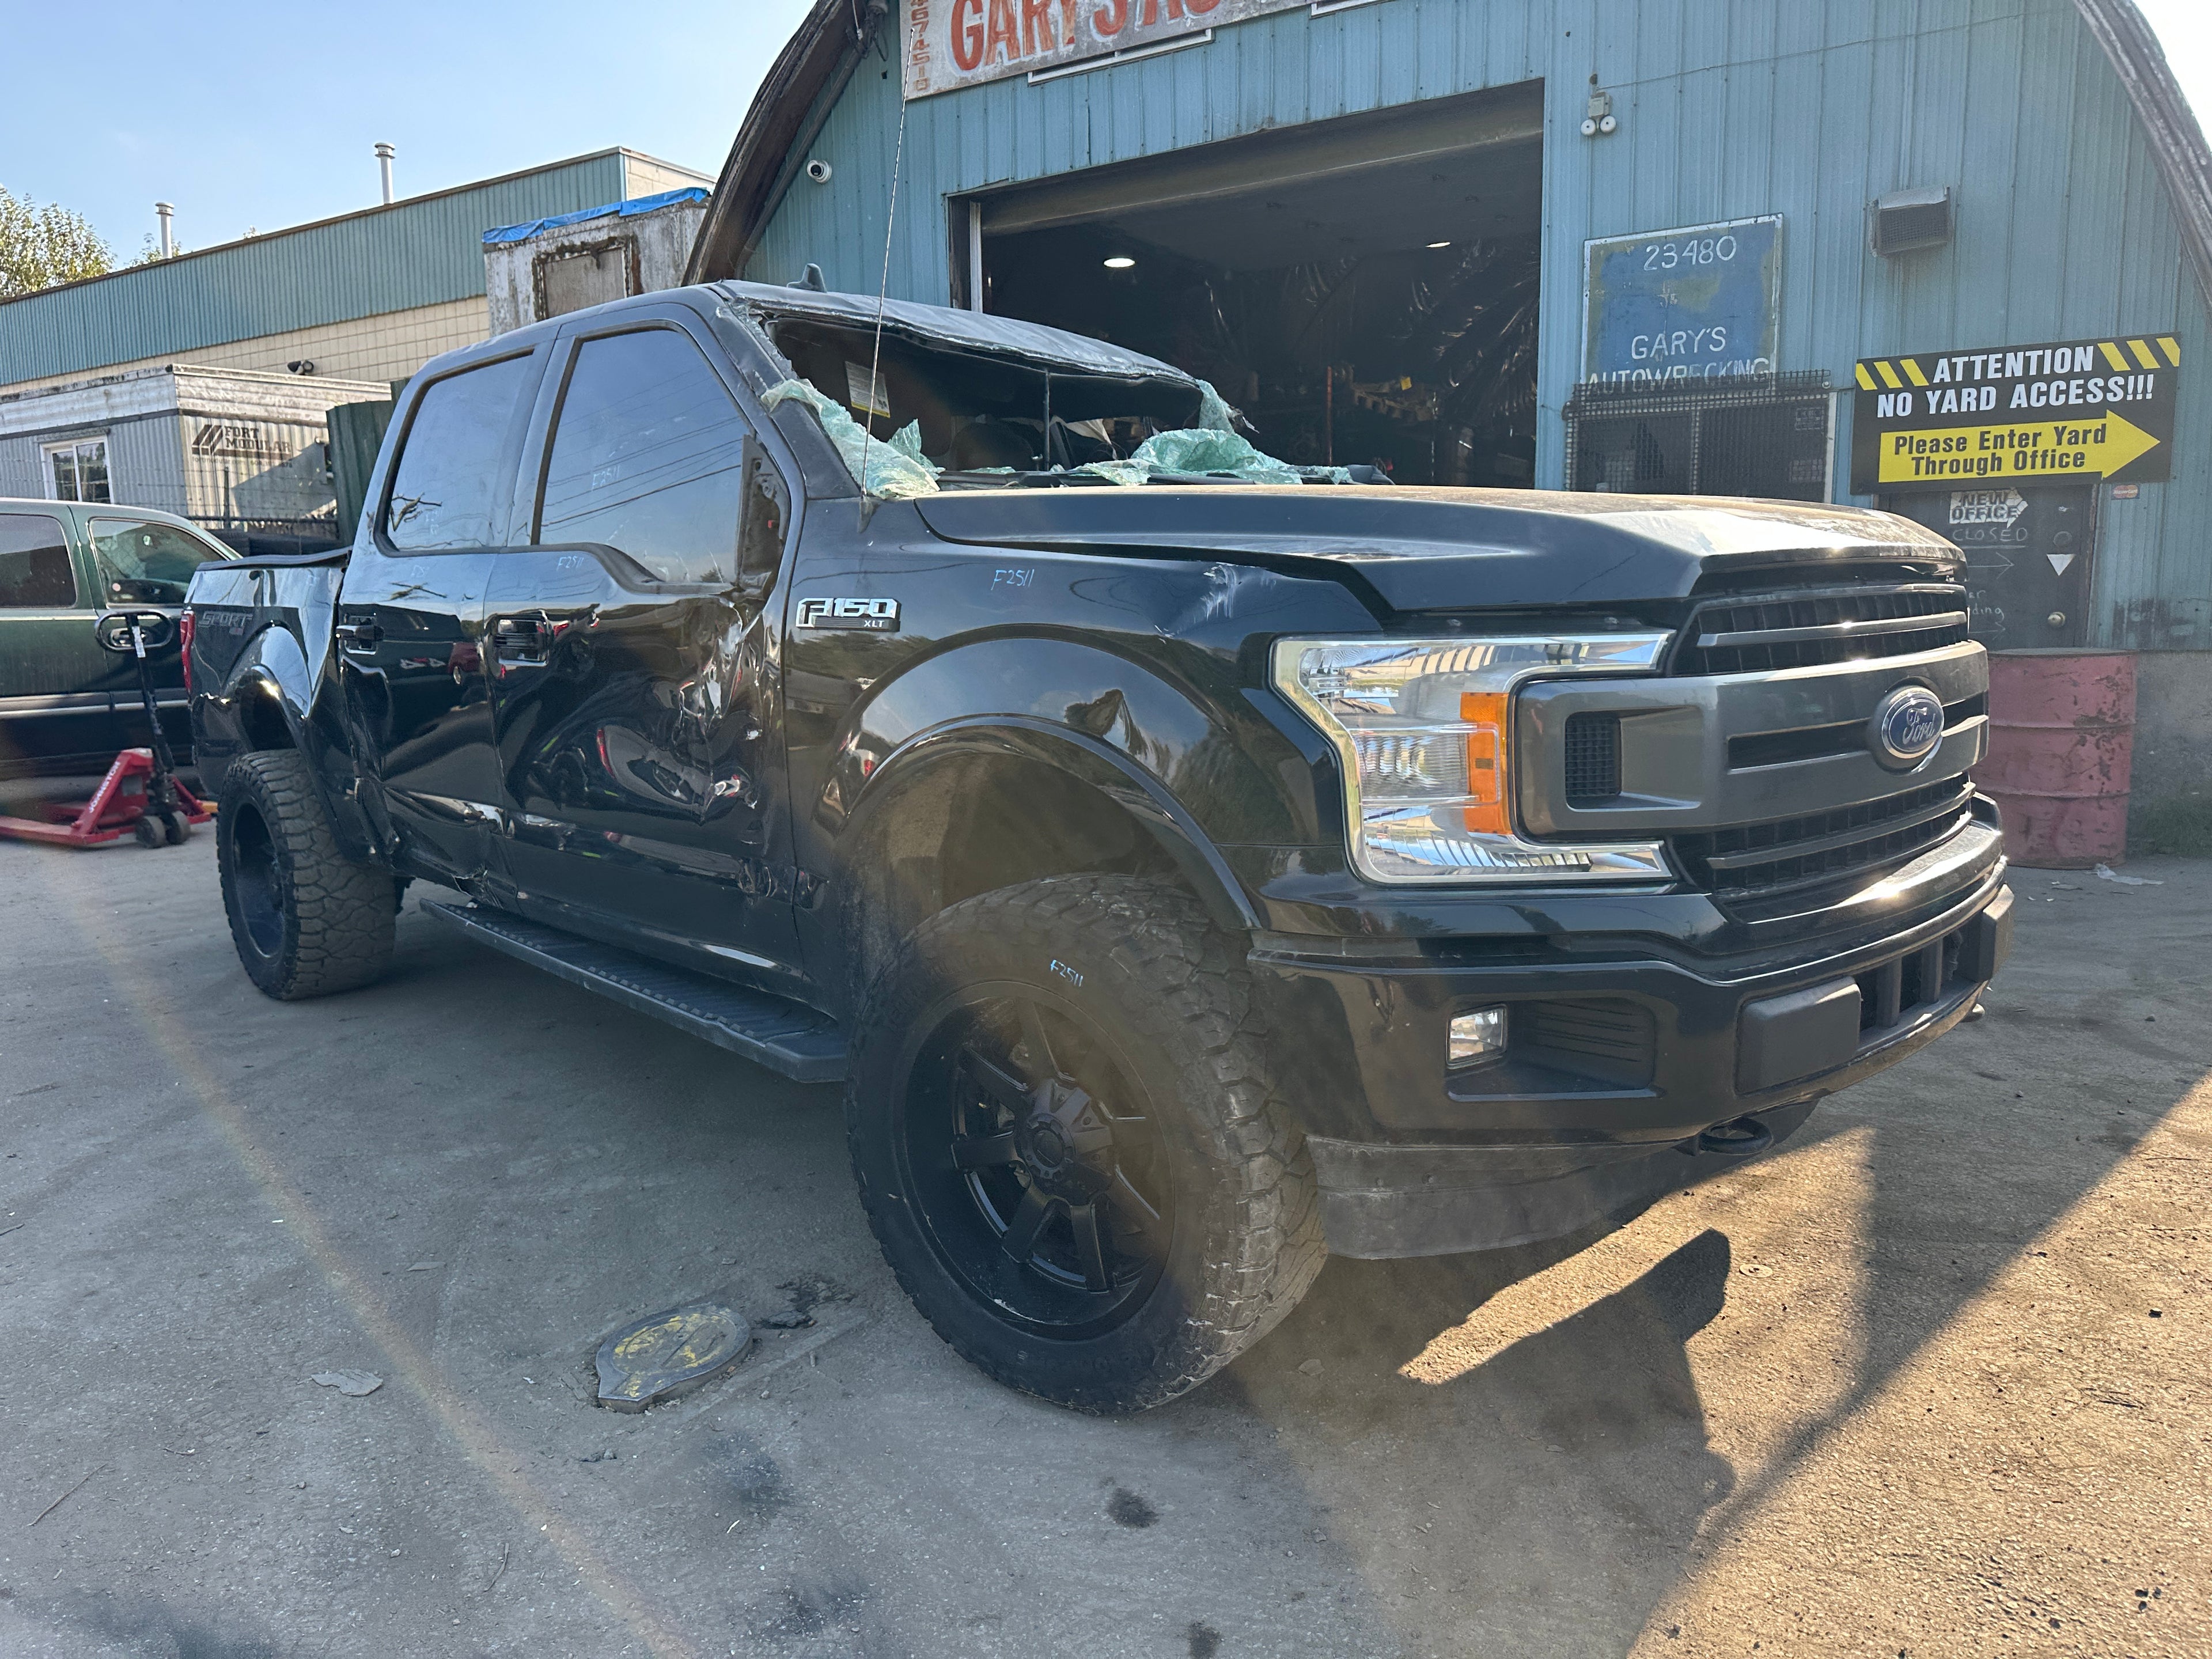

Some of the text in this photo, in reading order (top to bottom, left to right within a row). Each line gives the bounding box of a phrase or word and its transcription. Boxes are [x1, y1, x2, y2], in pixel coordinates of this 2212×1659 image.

[1643, 235, 1737, 271] 23480
[1631, 326, 1726, 359] GARY'S
[1932, 345, 2094, 383] ATTENTION
[1877, 374, 2154, 418] NO YARD ACCESS!!!
[224, 426, 259, 438] FORT
[1894, 423, 2107, 455] Please Enter Yard
[225, 437, 291, 453] MODULAR
[1911, 449, 2085, 476] Through Office
[1961, 491, 2009, 506] NEW
[1952, 505, 2018, 521] OFFICE
[1952, 527, 2028, 541] CLOSED
[991, 569, 1035, 591] F2511
[198, 611, 253, 628] SPORT
[864, 620, 885, 628] XLT
[1902, 707, 1936, 745] Ford
[1050, 959, 1084, 987] F2511
